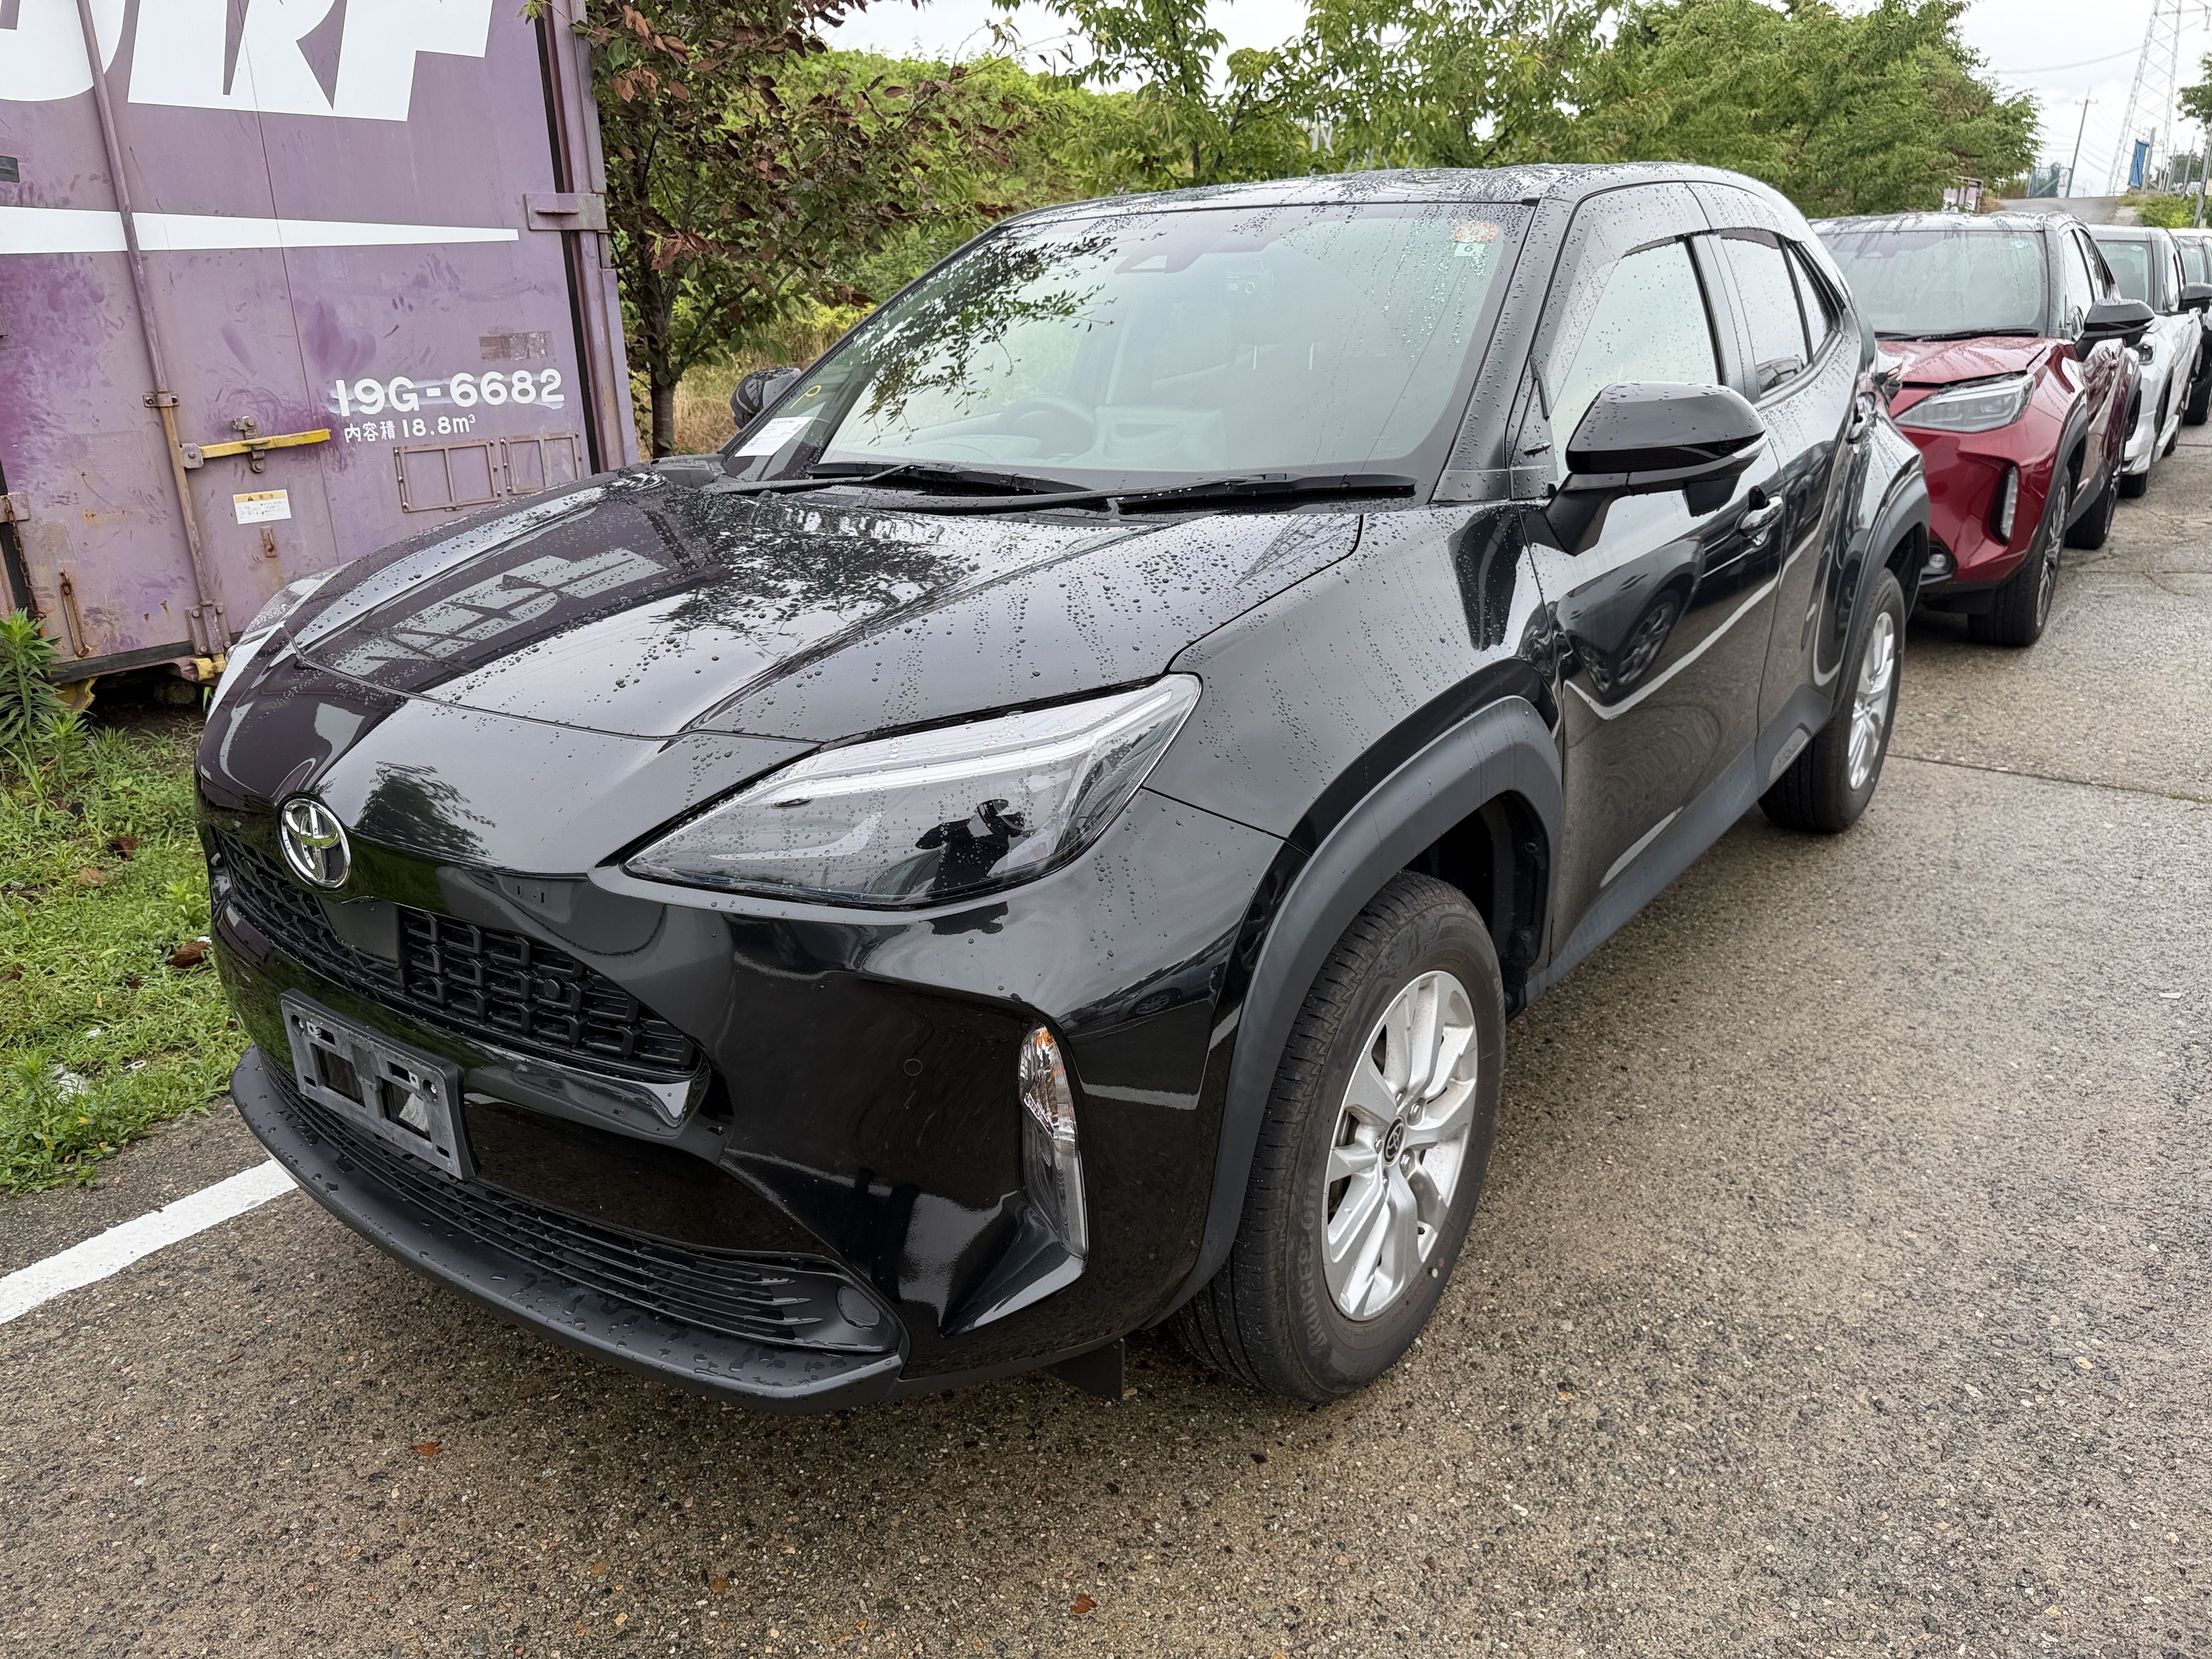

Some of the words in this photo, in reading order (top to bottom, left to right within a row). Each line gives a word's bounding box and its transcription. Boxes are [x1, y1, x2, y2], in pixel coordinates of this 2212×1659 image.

[335, 368, 565, 417] 19G-6682
[344, 420, 396, 443] 内容積
